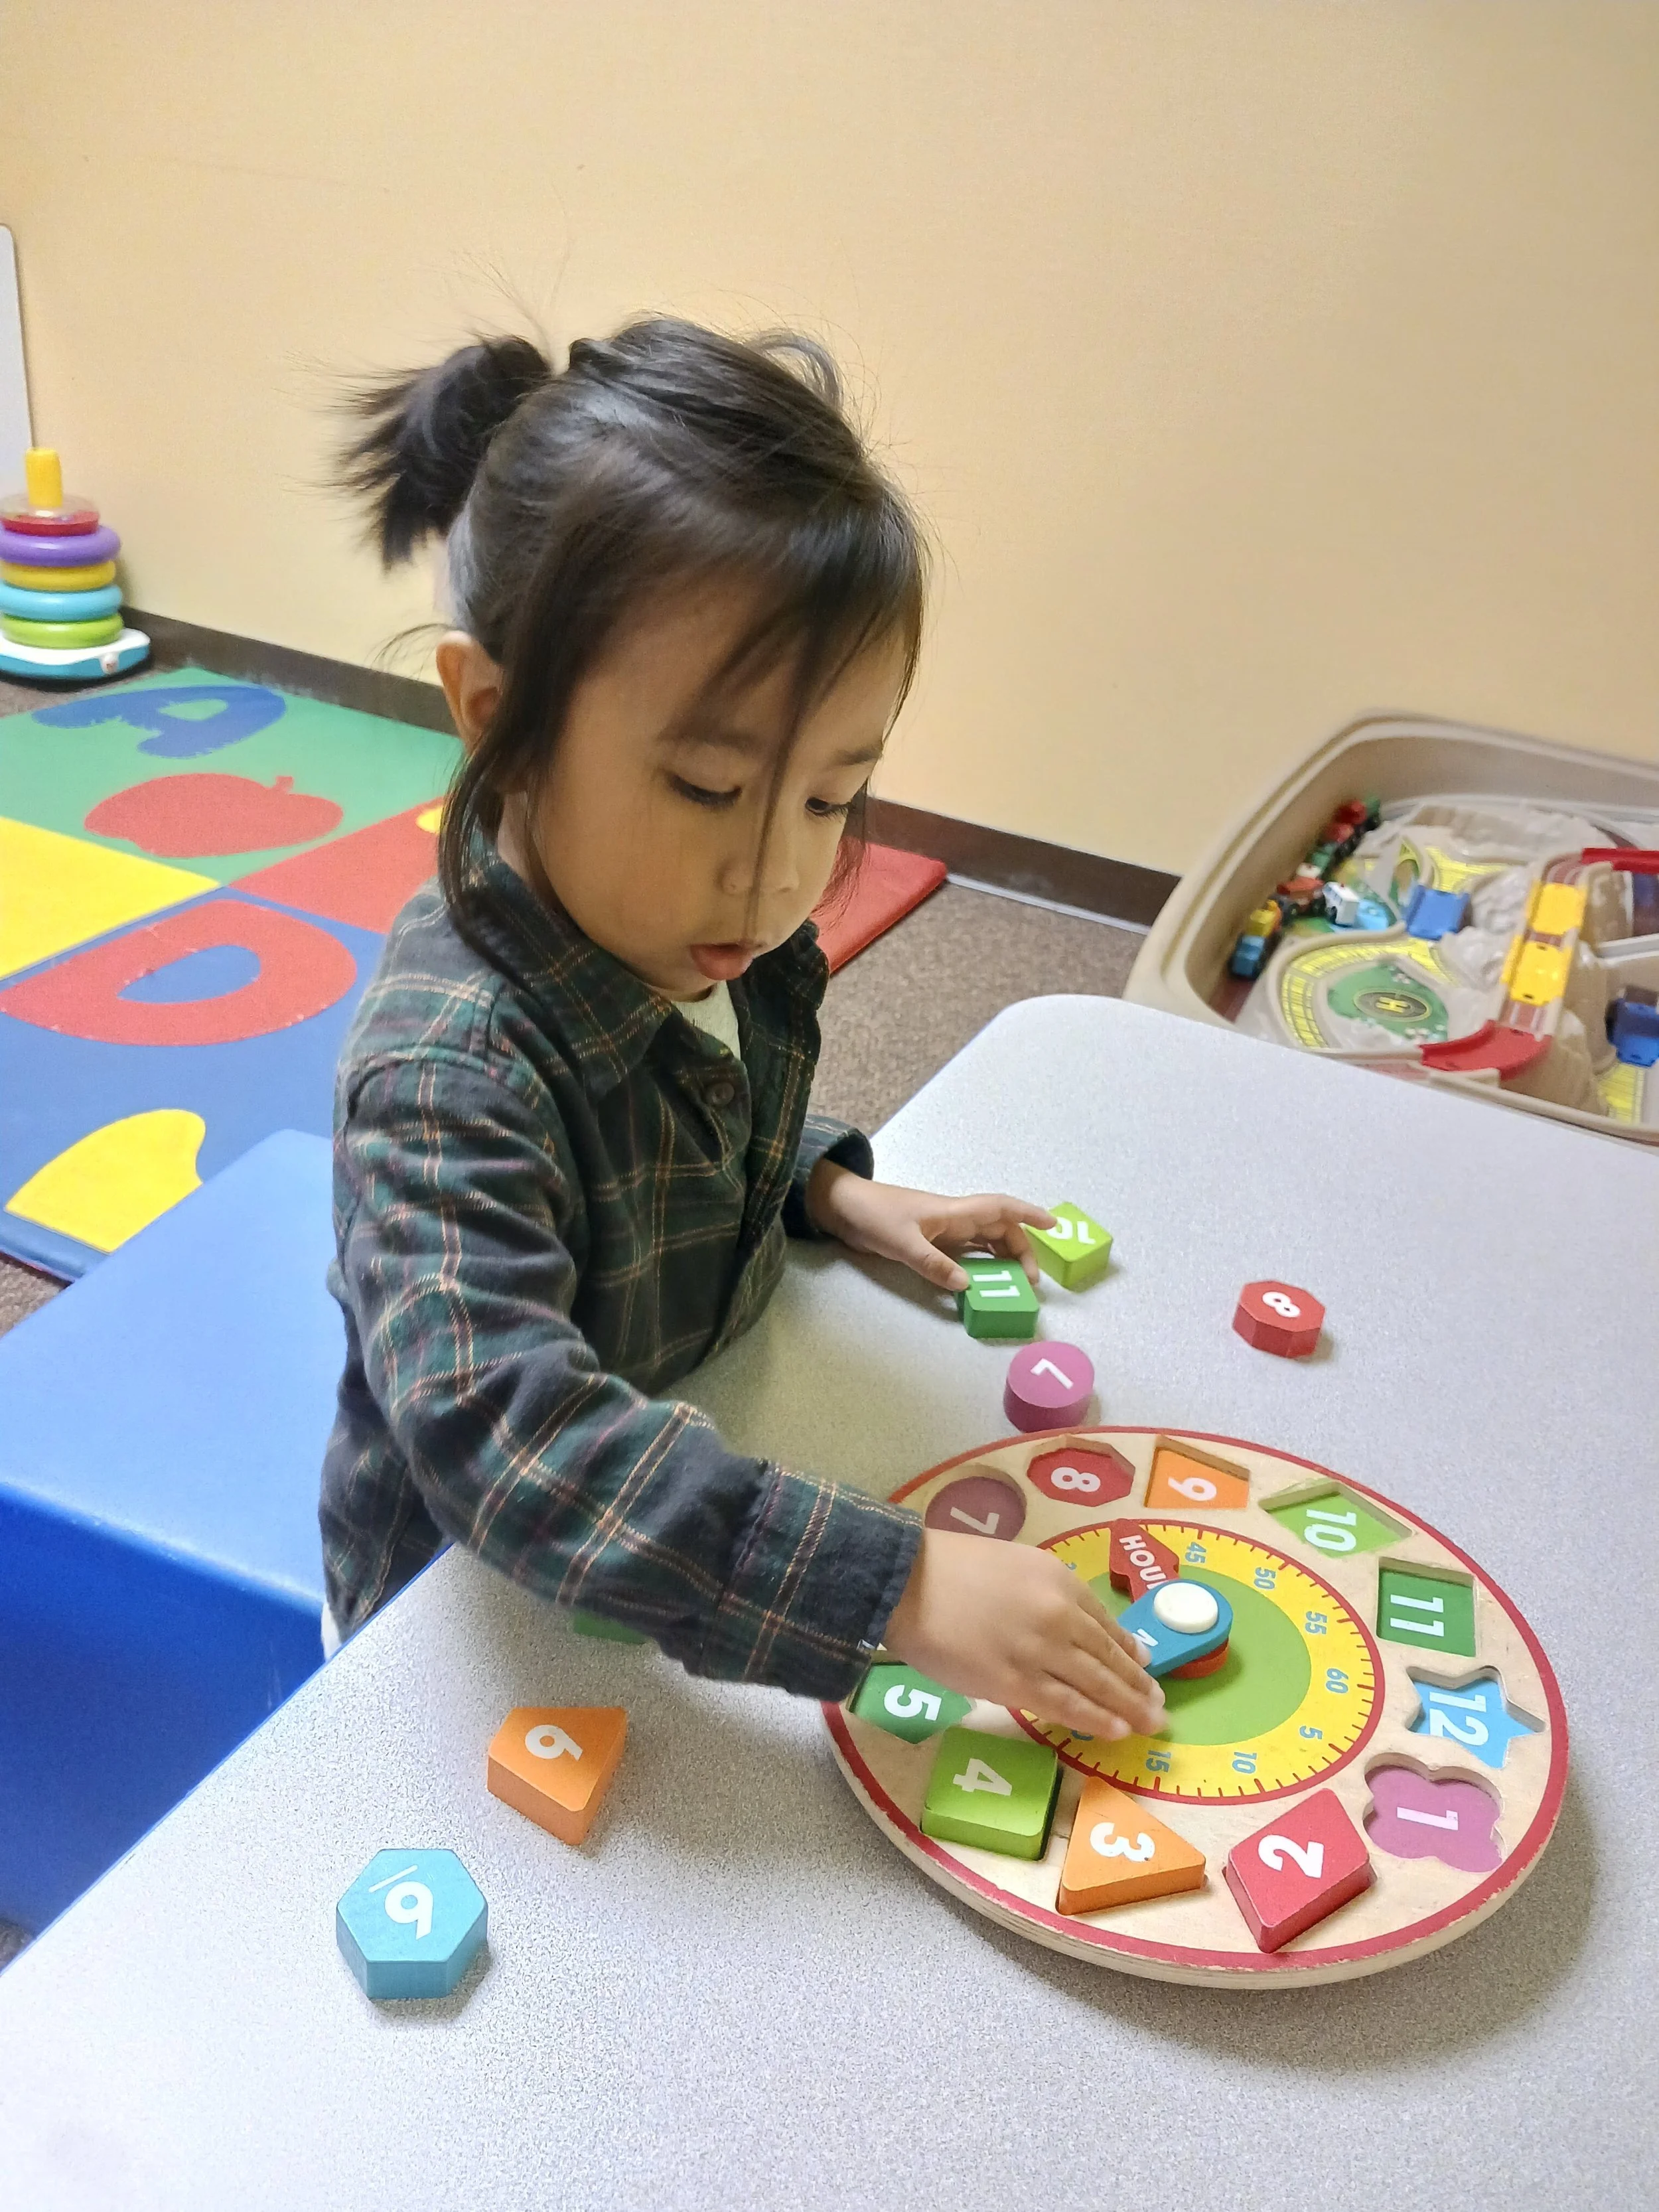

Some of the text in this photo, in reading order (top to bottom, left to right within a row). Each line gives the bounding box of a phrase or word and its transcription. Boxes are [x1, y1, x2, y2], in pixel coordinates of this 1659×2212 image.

[972, 1270, 1021, 1298] 11
[1263, 1292, 1300, 1317] 8
[1031, 1359, 1073, 1388] 7
[1050, 1467, 1101, 1492] 8
[1169, 1478, 1216, 1501] 9
[950, 1507, 999, 1534] 7
[1303, 1509, 1357, 1552] 10
[1185, 1542, 1206, 1564] 45
[1254, 1568, 1276, 1590] 50
[1305, 1612, 1327, 1635] 55
[1390, 1595, 1445, 1638] 11
[1325, 1668, 1348, 1694] 60
[885, 1685, 942, 1720] 5
[1429, 1692, 1489, 1746] 12
[1299, 1726, 1323, 1739] 5
[1146, 1751, 1172, 1771] 15
[1232, 1752, 1257, 1774] 10
[953, 1759, 1012, 1796] 4
[1398, 1807, 1458, 1830] 1
[1090, 1822, 1155, 1862] 3
[1258, 1834, 1325, 1878] 2
